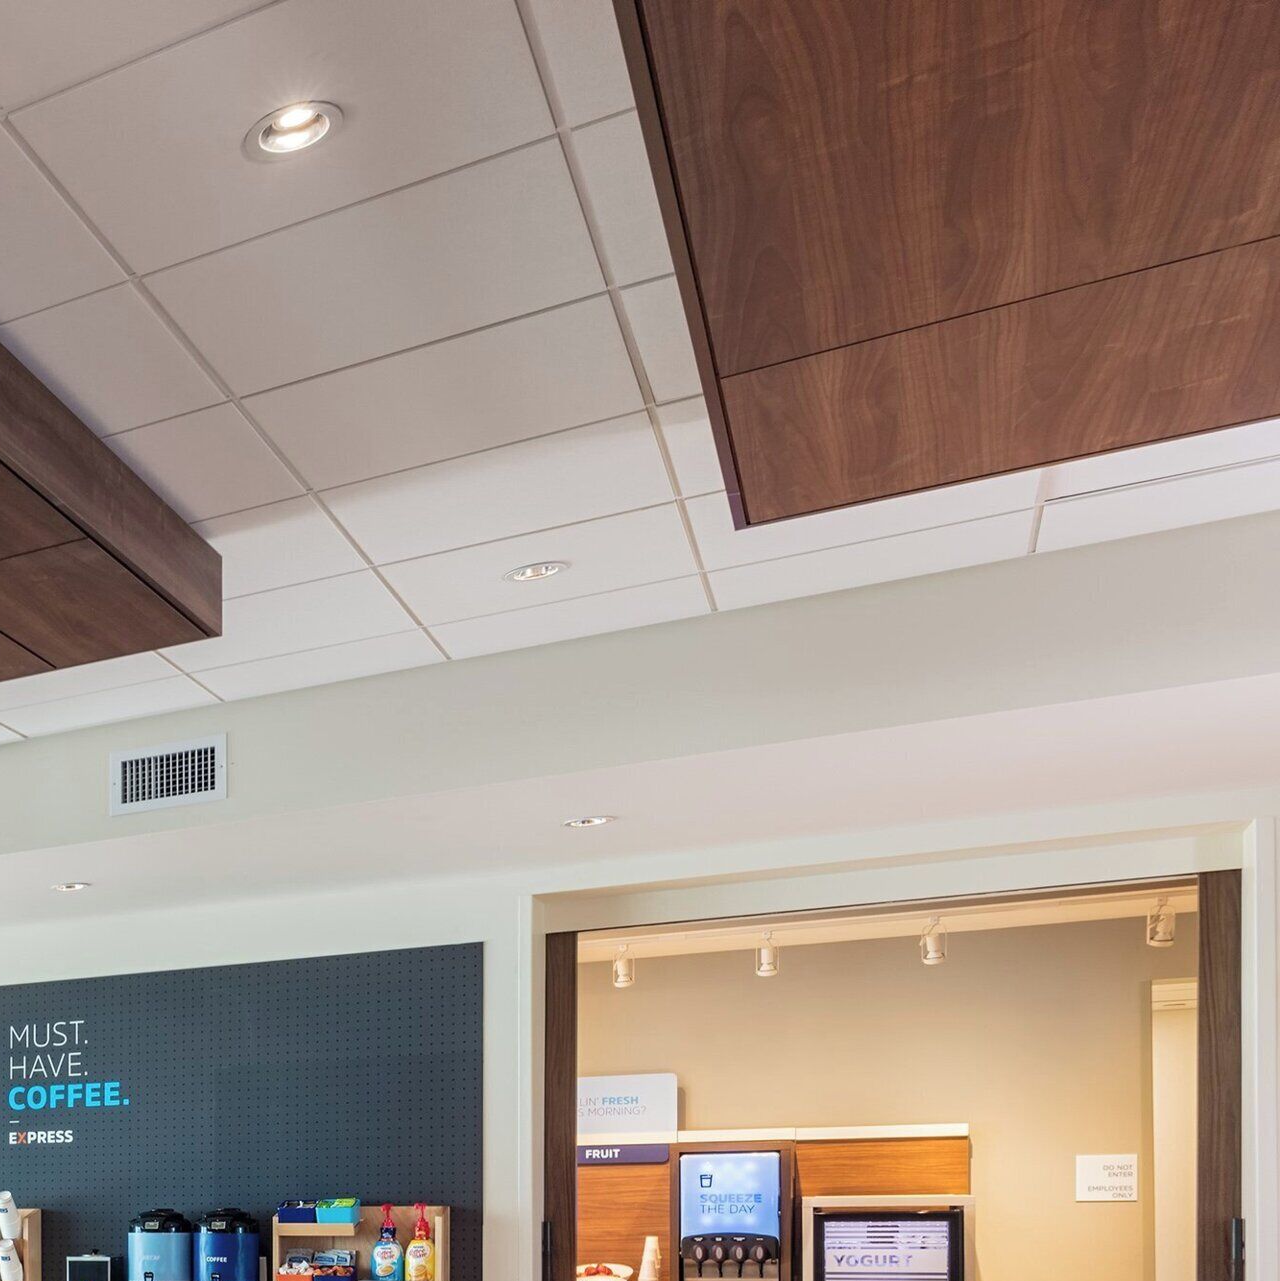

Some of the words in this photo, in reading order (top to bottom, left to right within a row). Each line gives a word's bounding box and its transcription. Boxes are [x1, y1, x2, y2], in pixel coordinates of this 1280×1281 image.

[9, 1020, 89, 1049] MUST.
[9, 1052, 89, 1080] HAVE.
[8, 1081, 130, 1111] COFFEE.
[602, 1096, 639, 1105] FRESH
[588, 1105, 647, 1117] MORNING?
[8, 1130, 74, 1145] EXPRESS
[585, 1149, 621, 1159] FRUIT
[700, 1193, 762, 1203] SQUEEZE
[700, 1204, 724, 1214] THE
[729, 1204, 755, 1214] DAY
[833, 1254, 913, 1267] YOGURT
